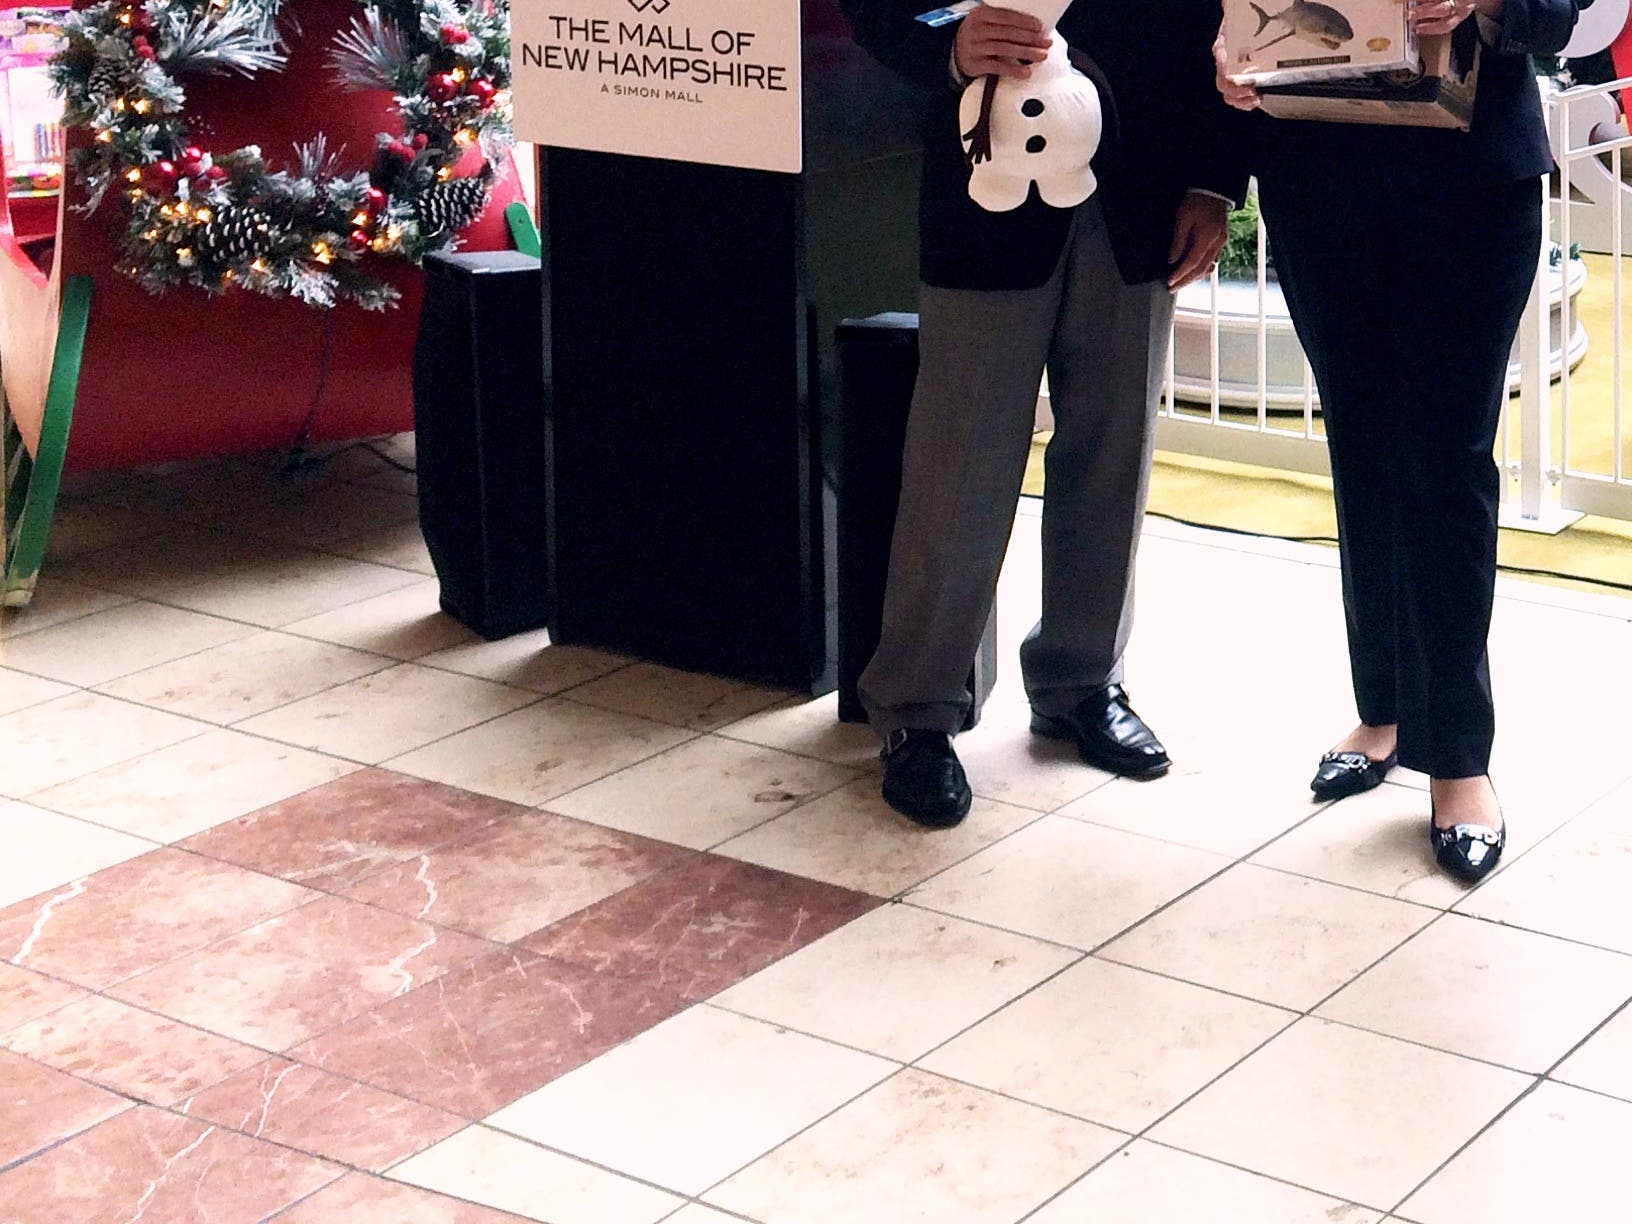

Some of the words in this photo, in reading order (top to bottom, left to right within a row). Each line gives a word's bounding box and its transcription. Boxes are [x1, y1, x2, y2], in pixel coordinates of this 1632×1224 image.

[549, 15, 610, 44] THE
[619, 22, 703, 52] MALL
[711, 30, 755, 56] OF
[522, 43, 589, 71] NEW
[598, 50, 787, 91] HAMPSHIRE
[600, 83, 609, 94] A
[614, 85, 660, 99] SIMON
[665, 89, 703, 104] MALL
